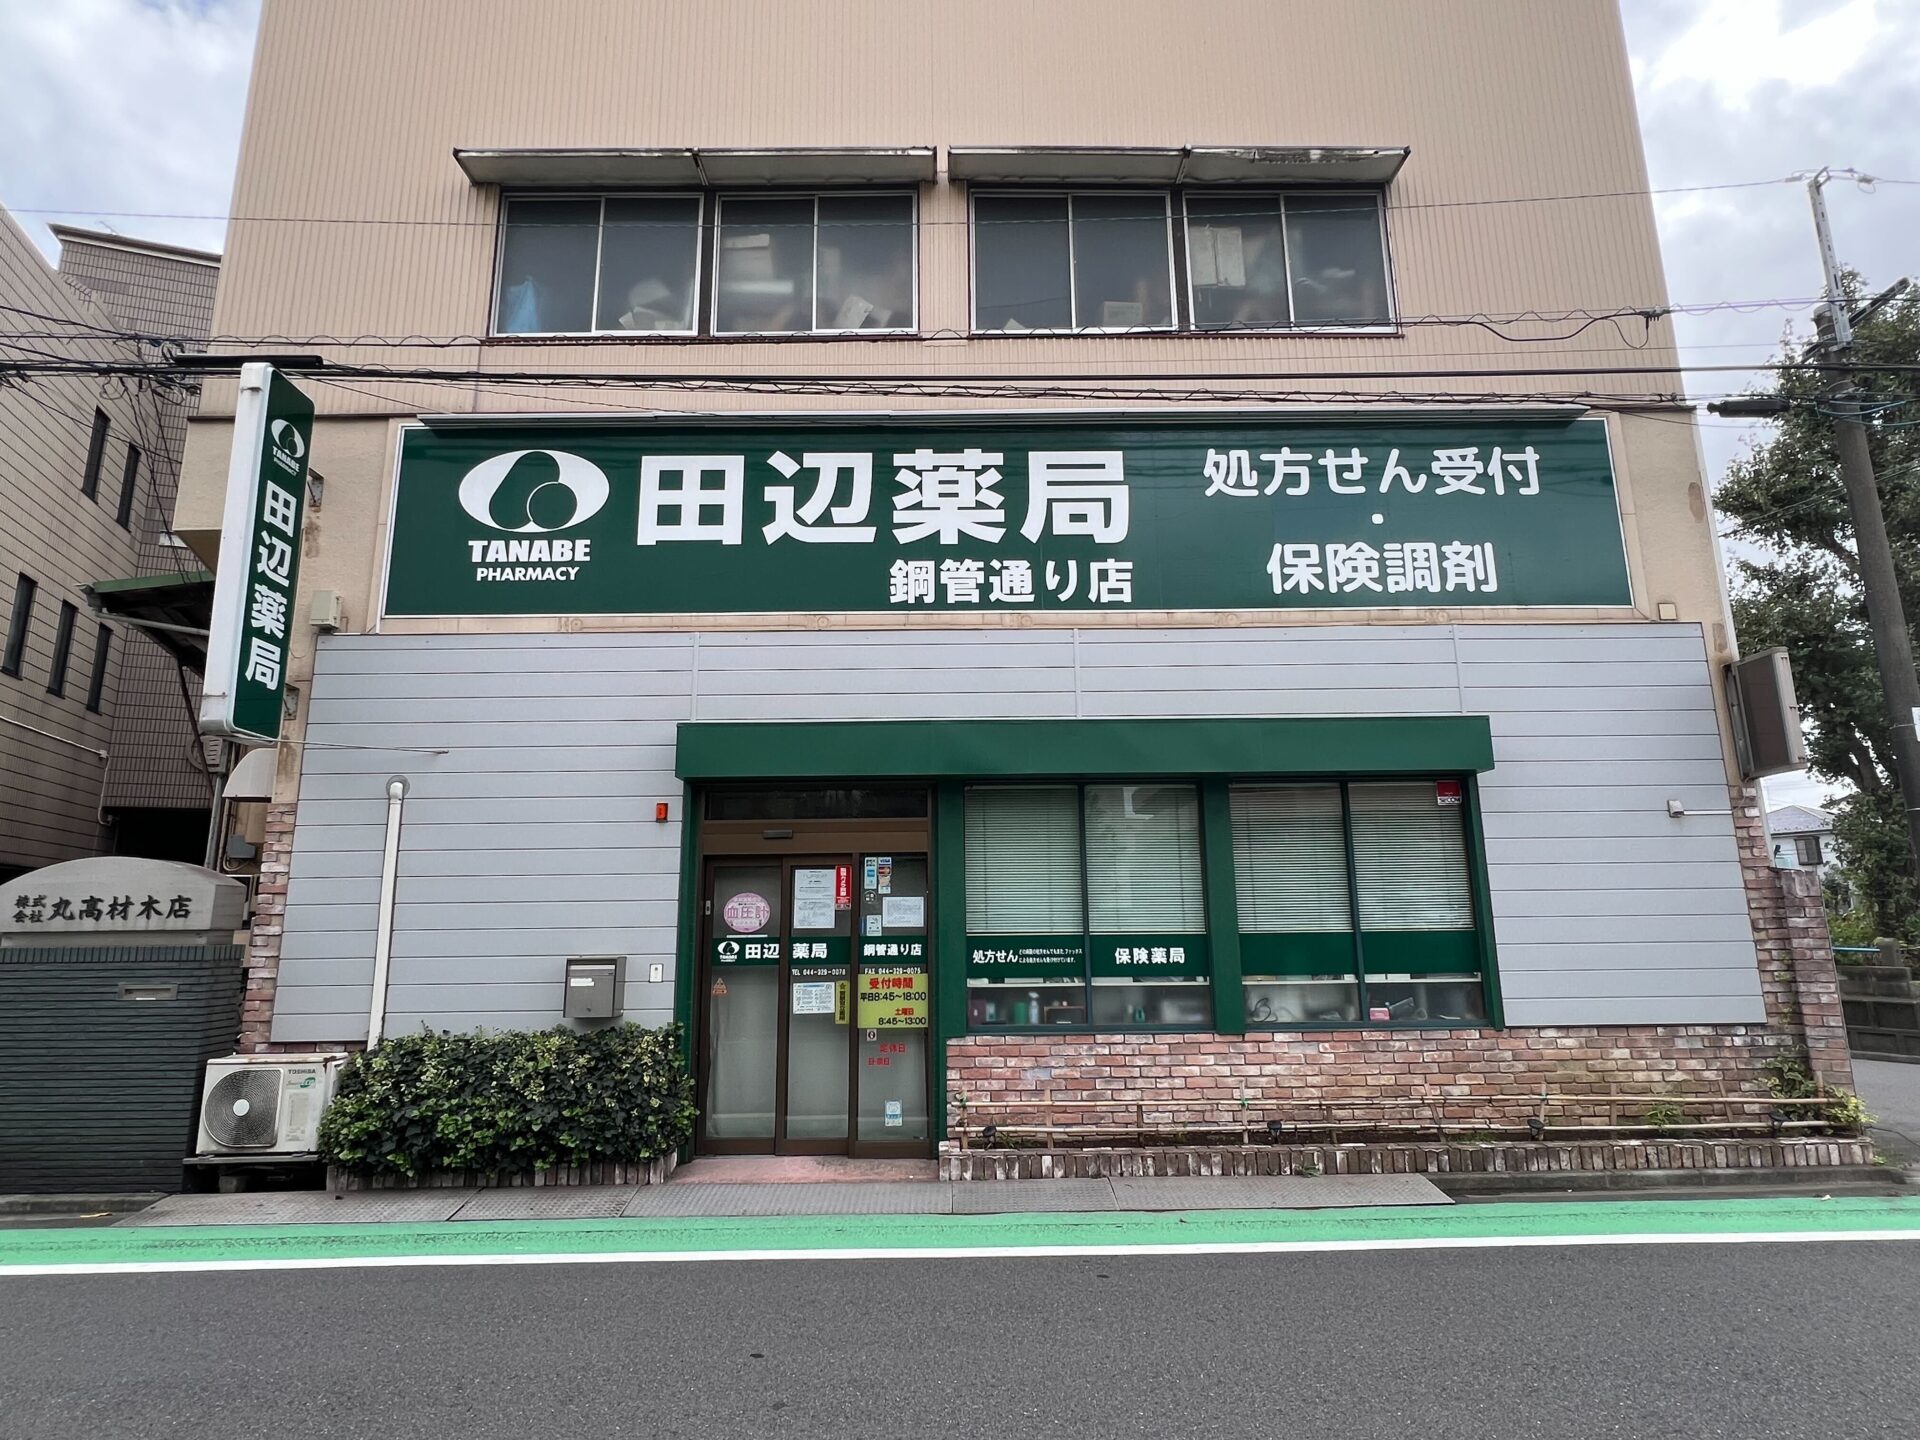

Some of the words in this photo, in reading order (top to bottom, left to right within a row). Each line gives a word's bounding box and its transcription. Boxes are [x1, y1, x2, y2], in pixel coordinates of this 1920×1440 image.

[272, 445, 300, 472] TANABE
[1203, 446, 1540, 497] 処方せん受付
[636, 448, 1130, 547] 田辺薬局
[468, 540, 591, 563] TANABE
[476, 567, 579, 582] PHARMACY
[1267, 541, 1499, 595] 保険調剤
[245, 479, 297, 691] 田辺薬局
[889, 558, 1134, 605] 鋼管通り店
[14, 894, 47, 909] 株式
[12, 909, 45, 923] 会社
[745, 943, 780, 959] 田辺
[792, 943, 828, 959] 薬局
[863, 943, 922, 956] 鋼管通り店
[972, 949, 1018, 964] 処方せん
[1114, 947, 1186, 964] 保険薬局
[869, 977, 913, 990] 受付時間
[895, 1007, 914, 1016] 土曜日
